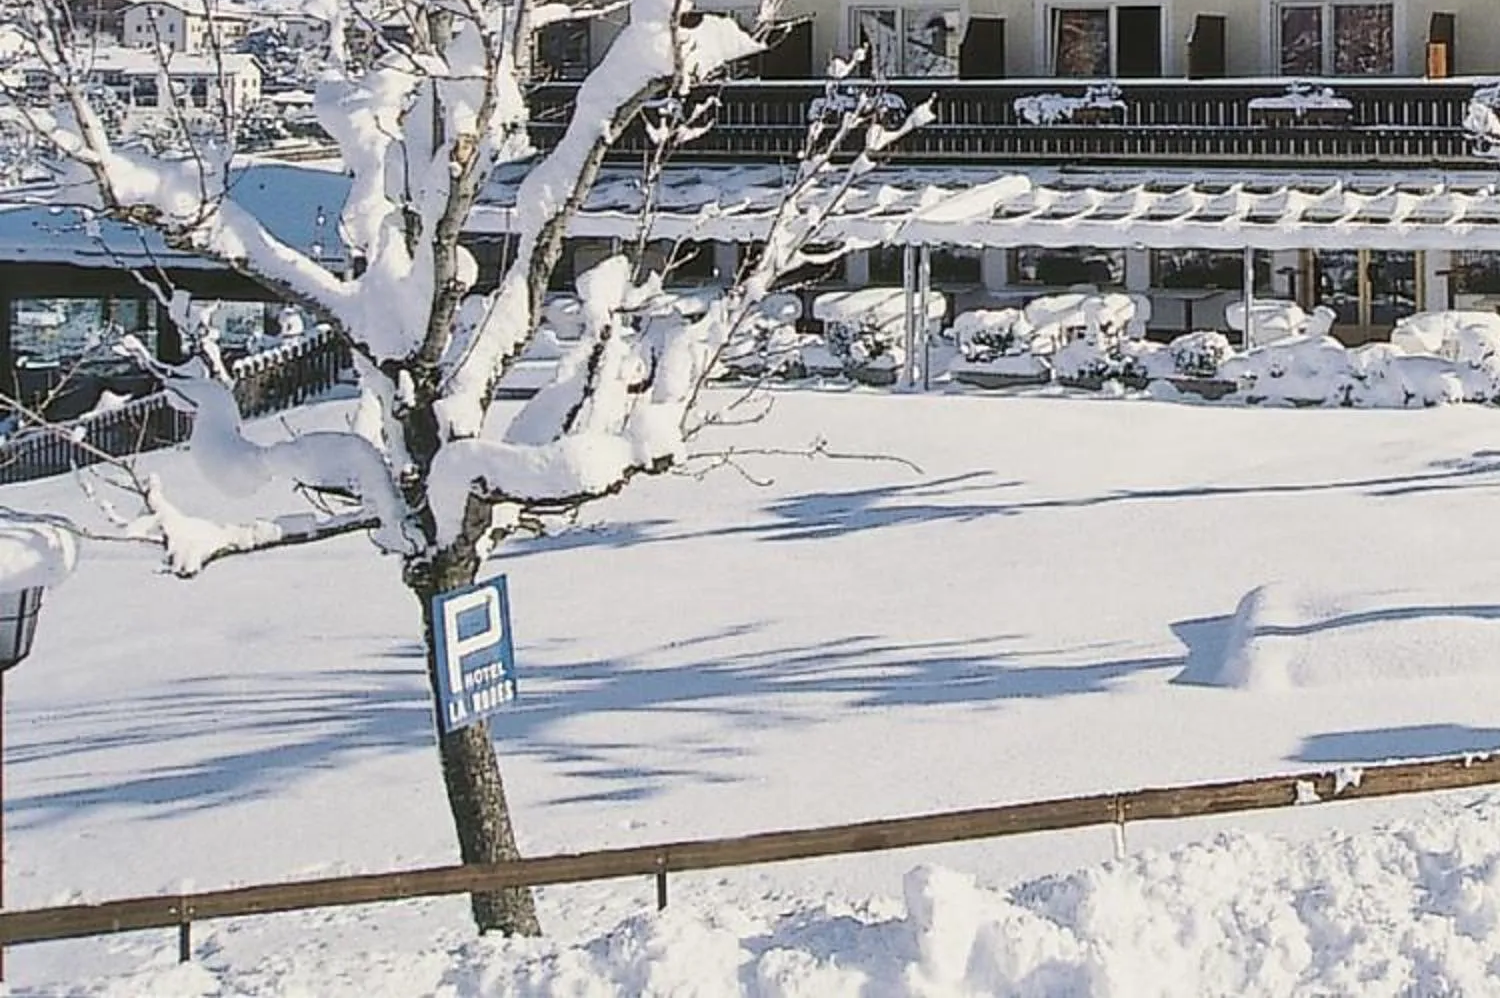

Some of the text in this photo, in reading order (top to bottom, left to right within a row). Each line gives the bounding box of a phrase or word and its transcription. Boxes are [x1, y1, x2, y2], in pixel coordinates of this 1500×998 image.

[443, 585, 502, 694] P
[463, 661, 506, 689] HOTEL
[448, 699, 468, 723] LA
